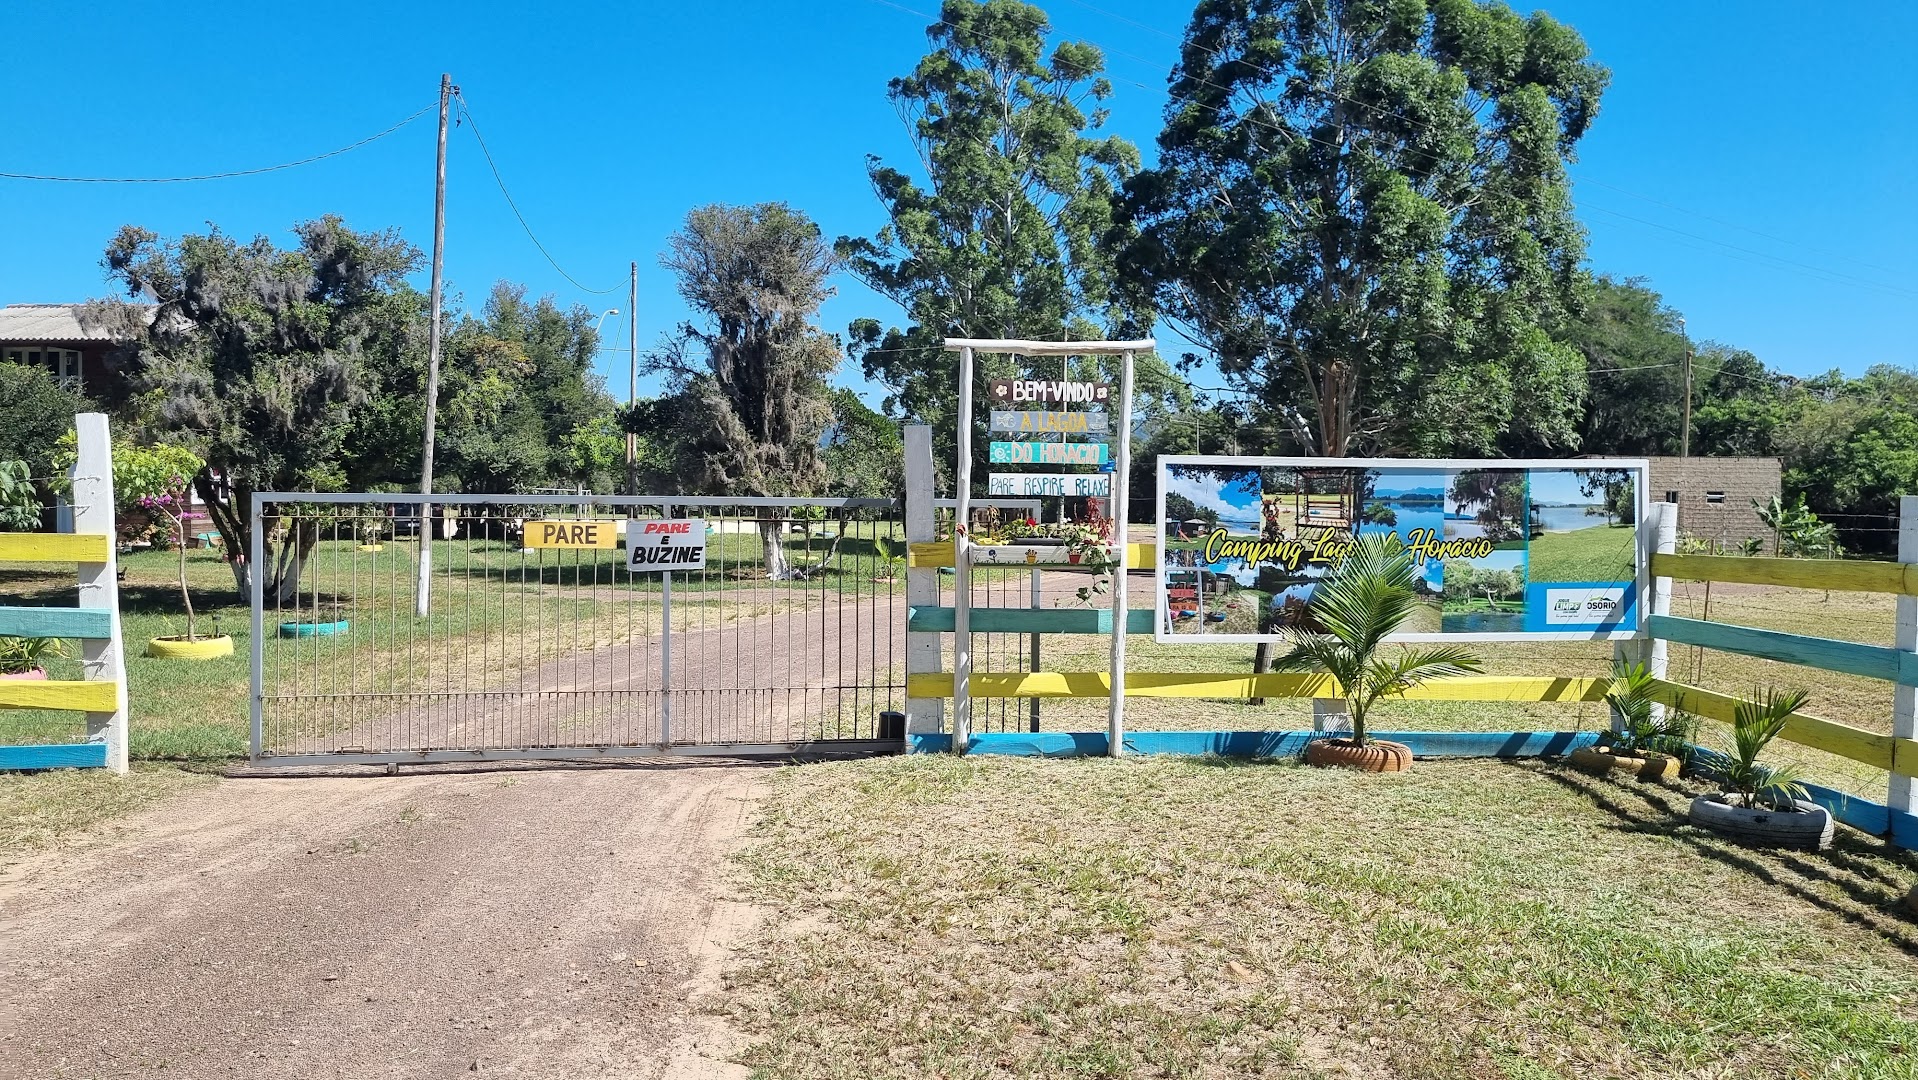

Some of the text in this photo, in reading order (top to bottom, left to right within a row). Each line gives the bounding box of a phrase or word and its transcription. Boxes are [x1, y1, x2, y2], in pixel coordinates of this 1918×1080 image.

[1012, 380, 1095, 402] BEM-VINDO
[1021, 411, 1088, 432] A LAGOA
[1011, 441, 1033, 463] DO
[991, 477, 1109, 496] PARE RESPIRE RELAXE
[543, 524, 597, 544] PARE
[644, 523, 691, 534] PARE
[661, 536, 670, 544] E
[1205, 528, 1305, 571] Camping
[1307, 526, 1356, 569] Lago
[1407, 528, 1494, 566] Horácio
[632, 546, 703, 564] BUZINE
